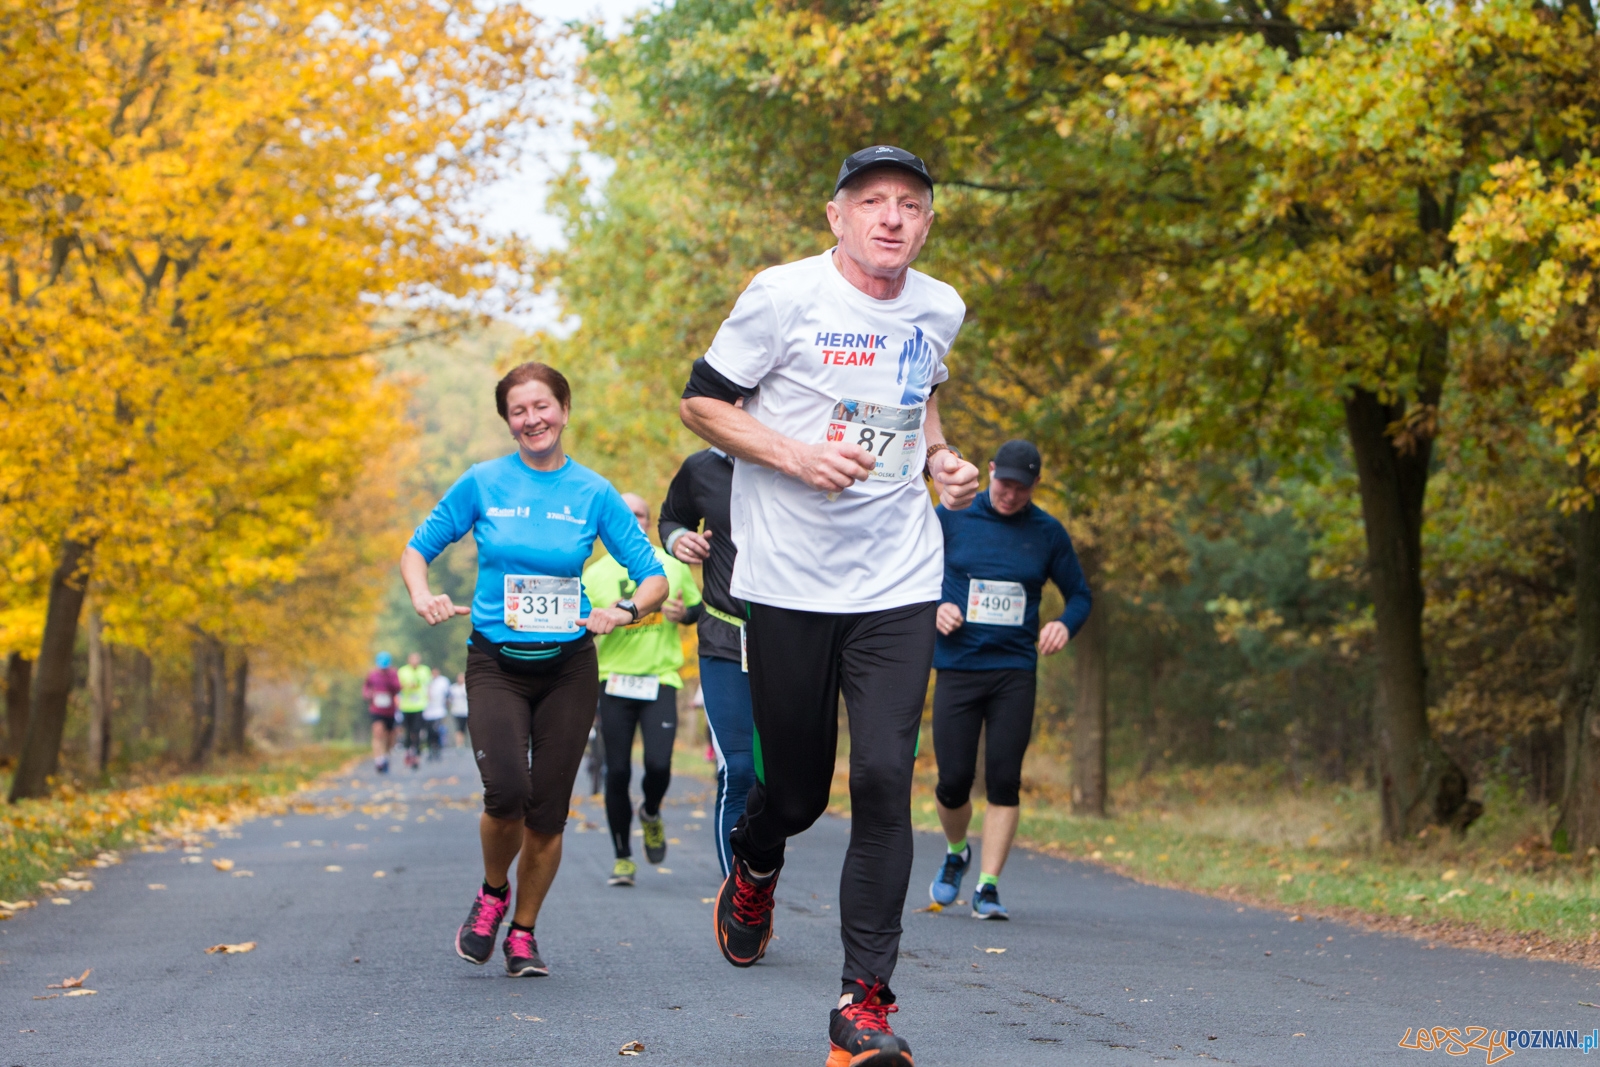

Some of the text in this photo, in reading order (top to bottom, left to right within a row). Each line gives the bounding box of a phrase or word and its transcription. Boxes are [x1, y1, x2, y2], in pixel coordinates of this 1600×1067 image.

[815, 332, 888, 349] HERNIK
[821, 350, 876, 367] TEAM
[857, 428, 897, 456] 87
[522, 595, 559, 615] 331
[981, 596, 1011, 611] 490
